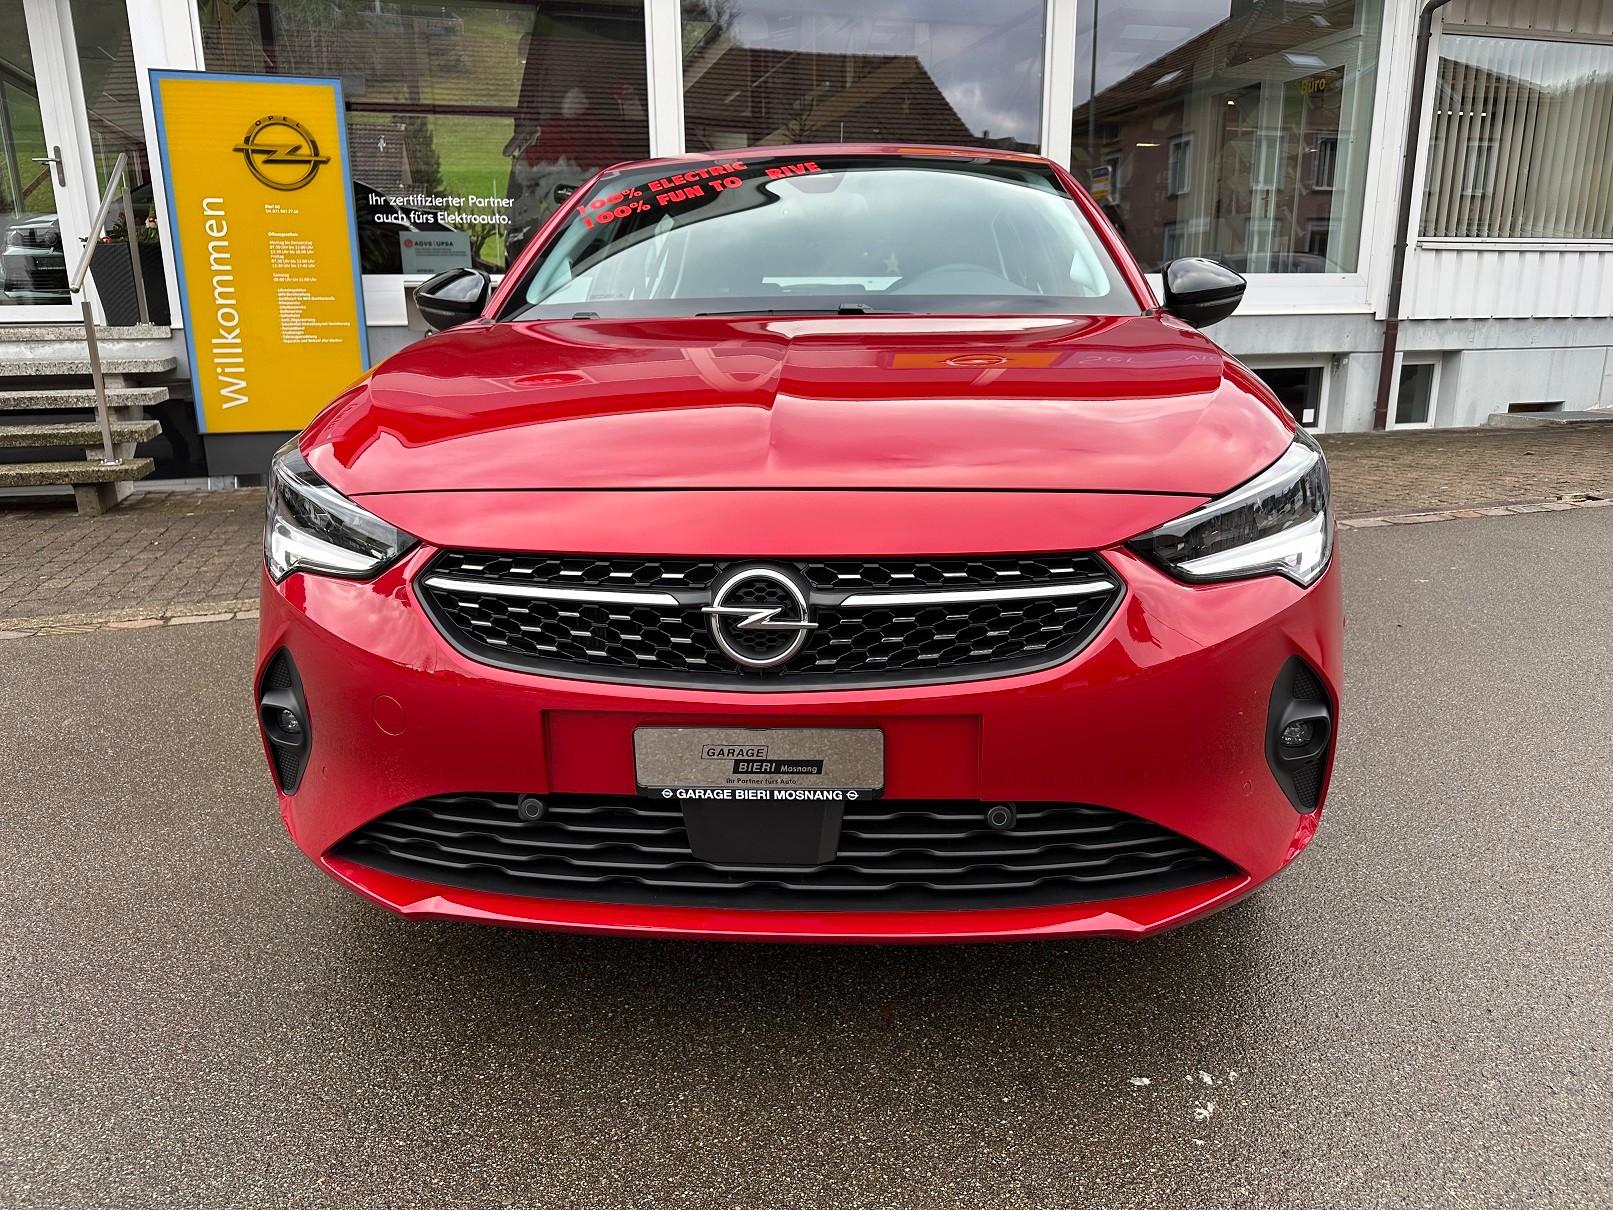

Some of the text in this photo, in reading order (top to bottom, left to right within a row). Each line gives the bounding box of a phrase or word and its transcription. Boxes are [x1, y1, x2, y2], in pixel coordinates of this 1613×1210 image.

[1300, 78, 1326, 95] Büro
[254, 115, 301, 129] OPEL
[576, 161, 748, 215] 100% ELECTRIC
[368, 193, 515, 207] Ihr zertifizierter Partner
[583, 200, 651, 229] 100%
[656, 185, 705, 206] FUN
[708, 176, 743, 192] TO
[374, 210, 512, 225] auch fürs Elektroauto.
[202, 197, 249, 410] Willkommen
[706, 748, 765, 758] GARAGE
[738, 762, 818, 774] BIERI Mosnang
[676, 789, 843, 801] GARAGE BIERI MOSNANG
